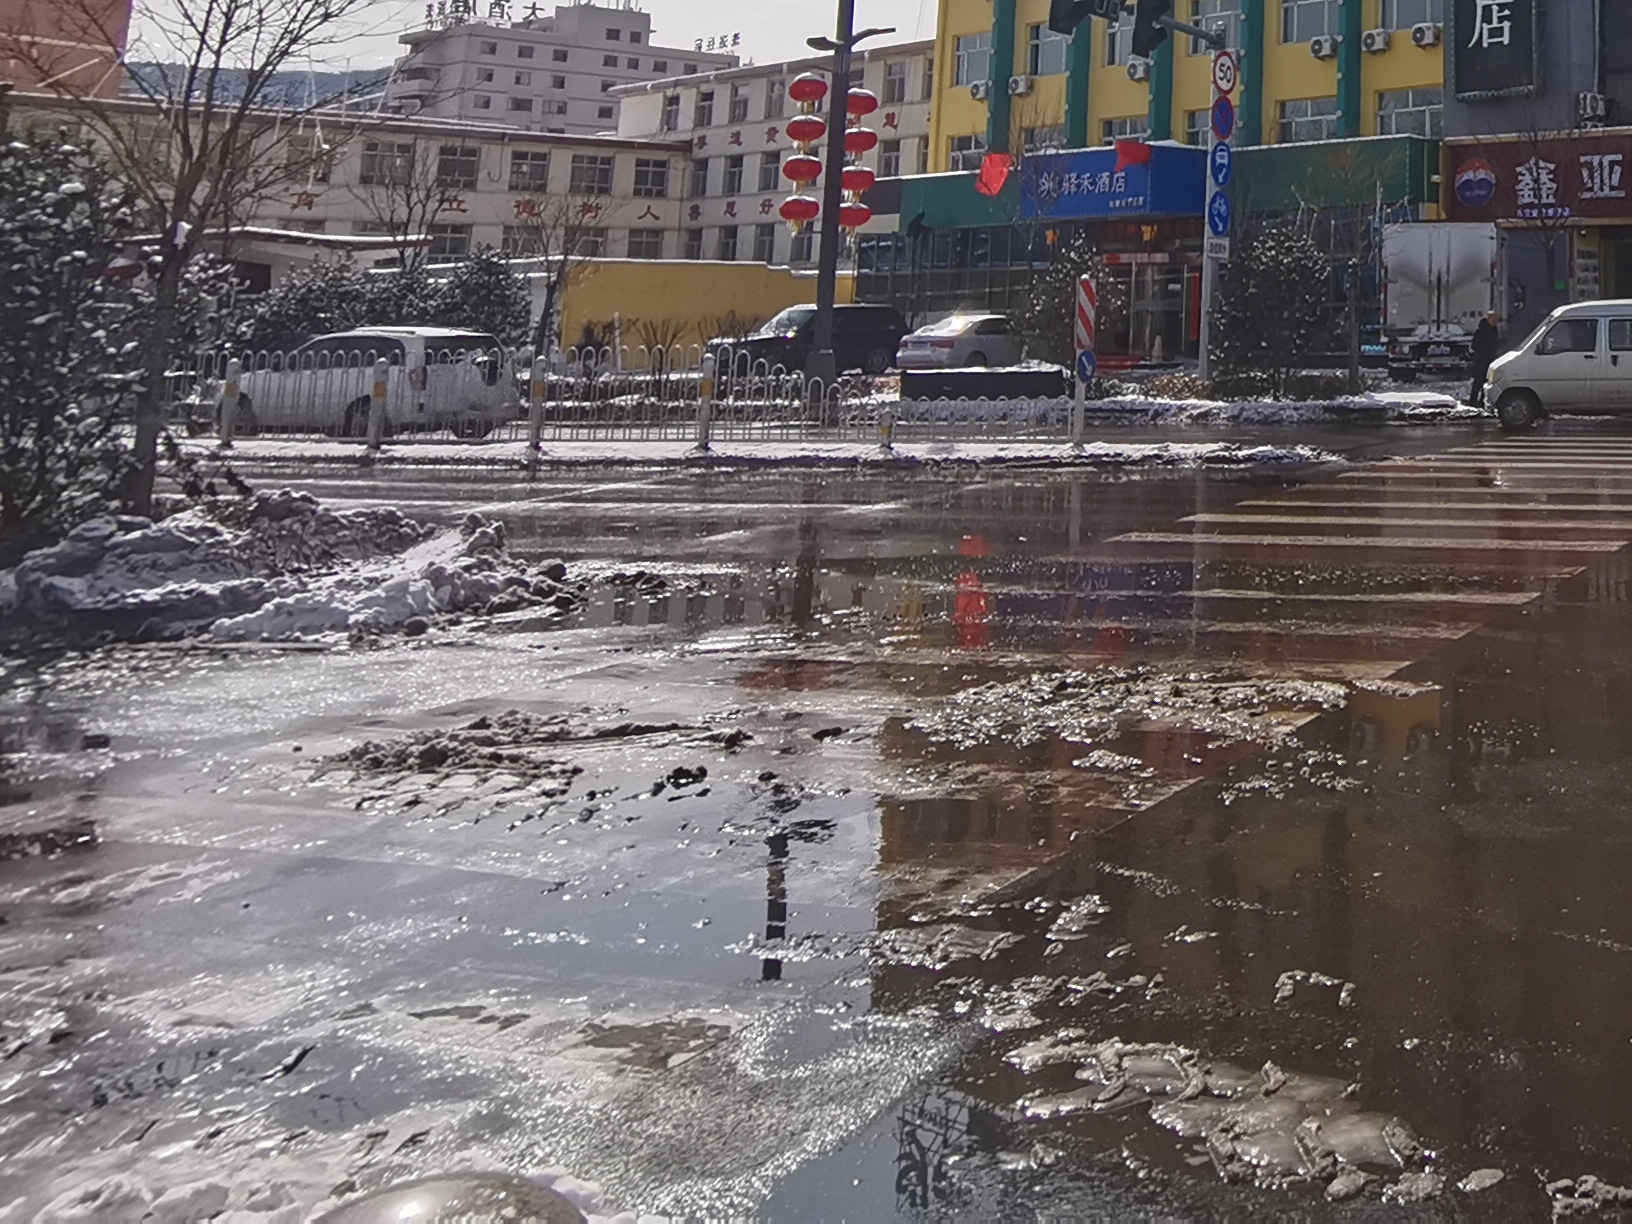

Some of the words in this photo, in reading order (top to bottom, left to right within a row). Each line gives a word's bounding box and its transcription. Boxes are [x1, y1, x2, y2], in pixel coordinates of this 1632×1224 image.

[1218, 62, 1232, 84] 50
[1061, 171, 1126, 195] 驿禾酒店
